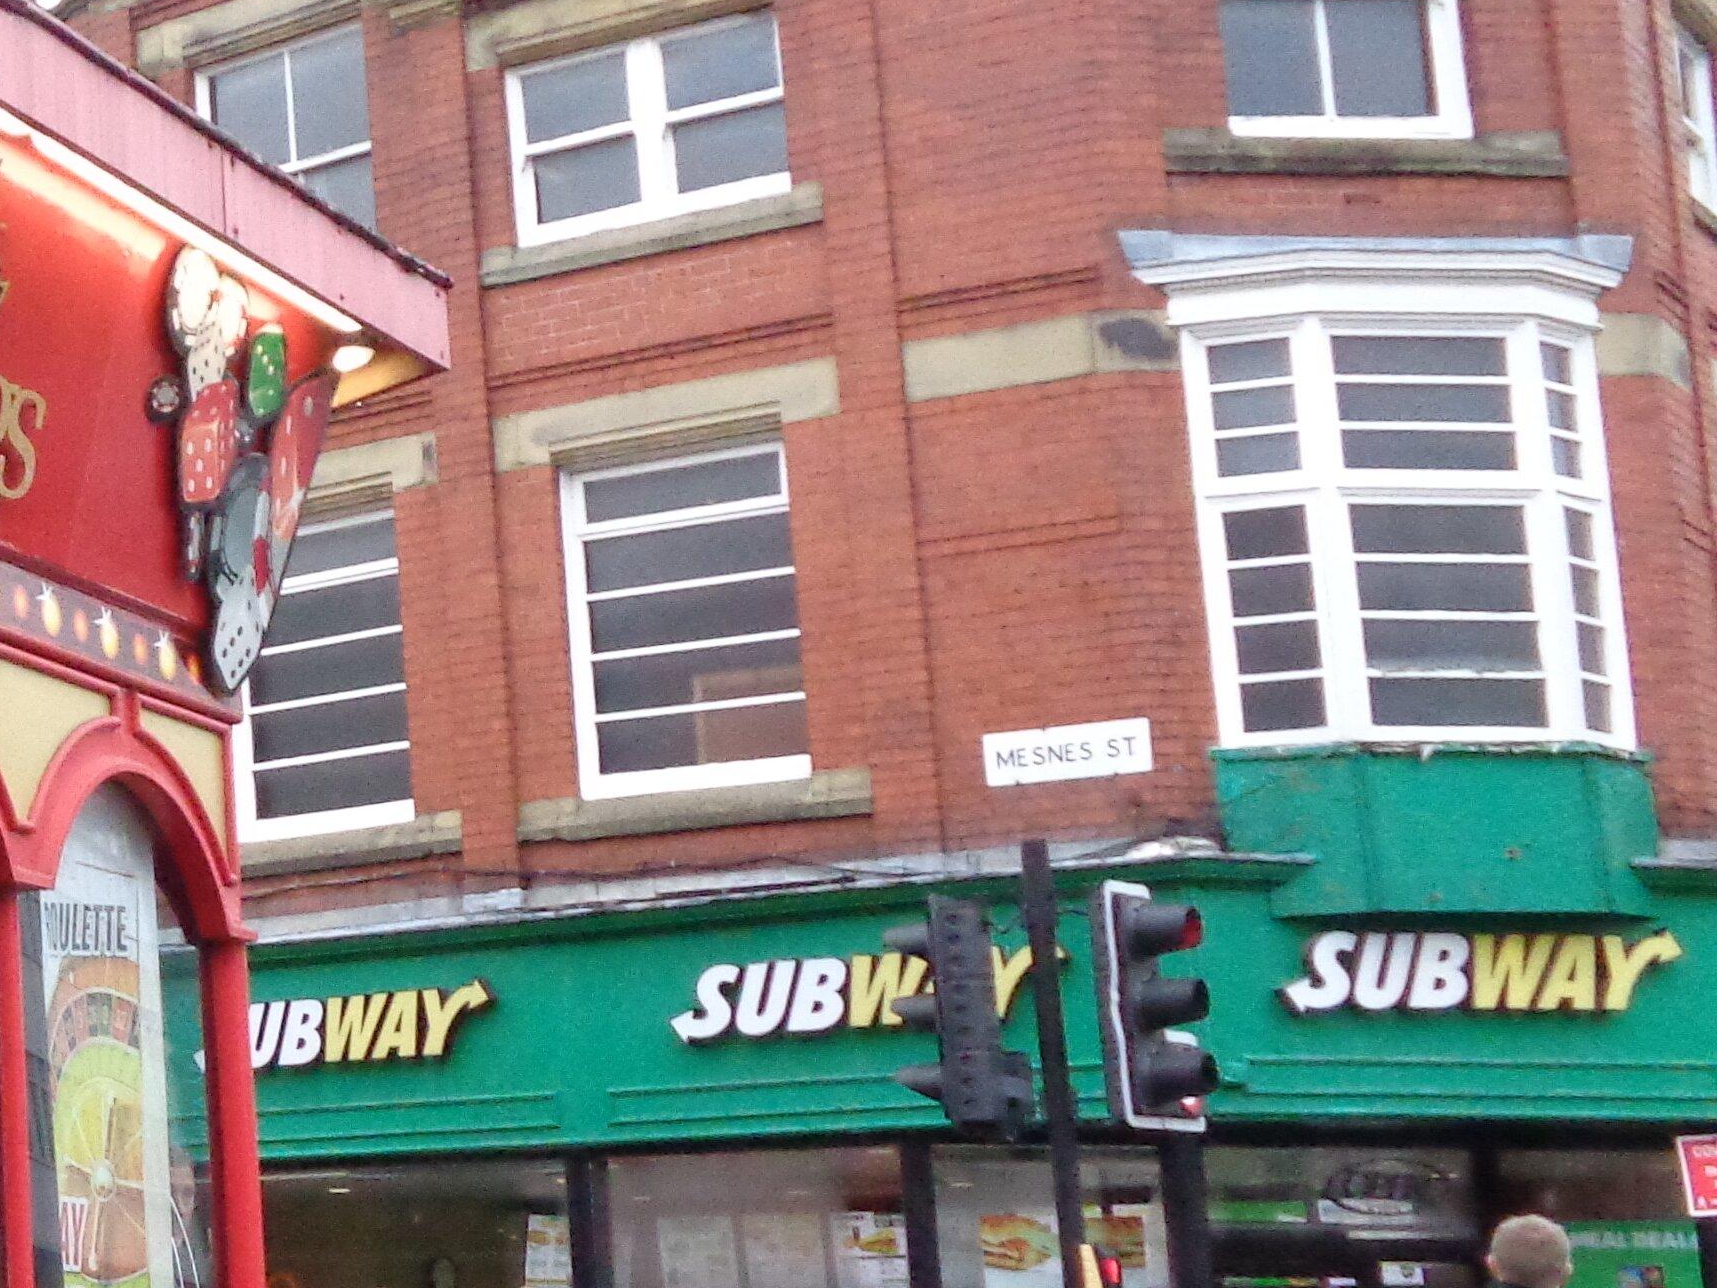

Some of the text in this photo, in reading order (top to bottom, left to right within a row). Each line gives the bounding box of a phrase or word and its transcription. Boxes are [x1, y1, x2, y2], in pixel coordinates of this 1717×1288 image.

[995, 736, 1138, 770] MESNES ST
[669, 945, 1070, 1044] SUBWY
[1276, 928, 1684, 1014] SUBWAY
[247, 978, 493, 1070] UBWAY
